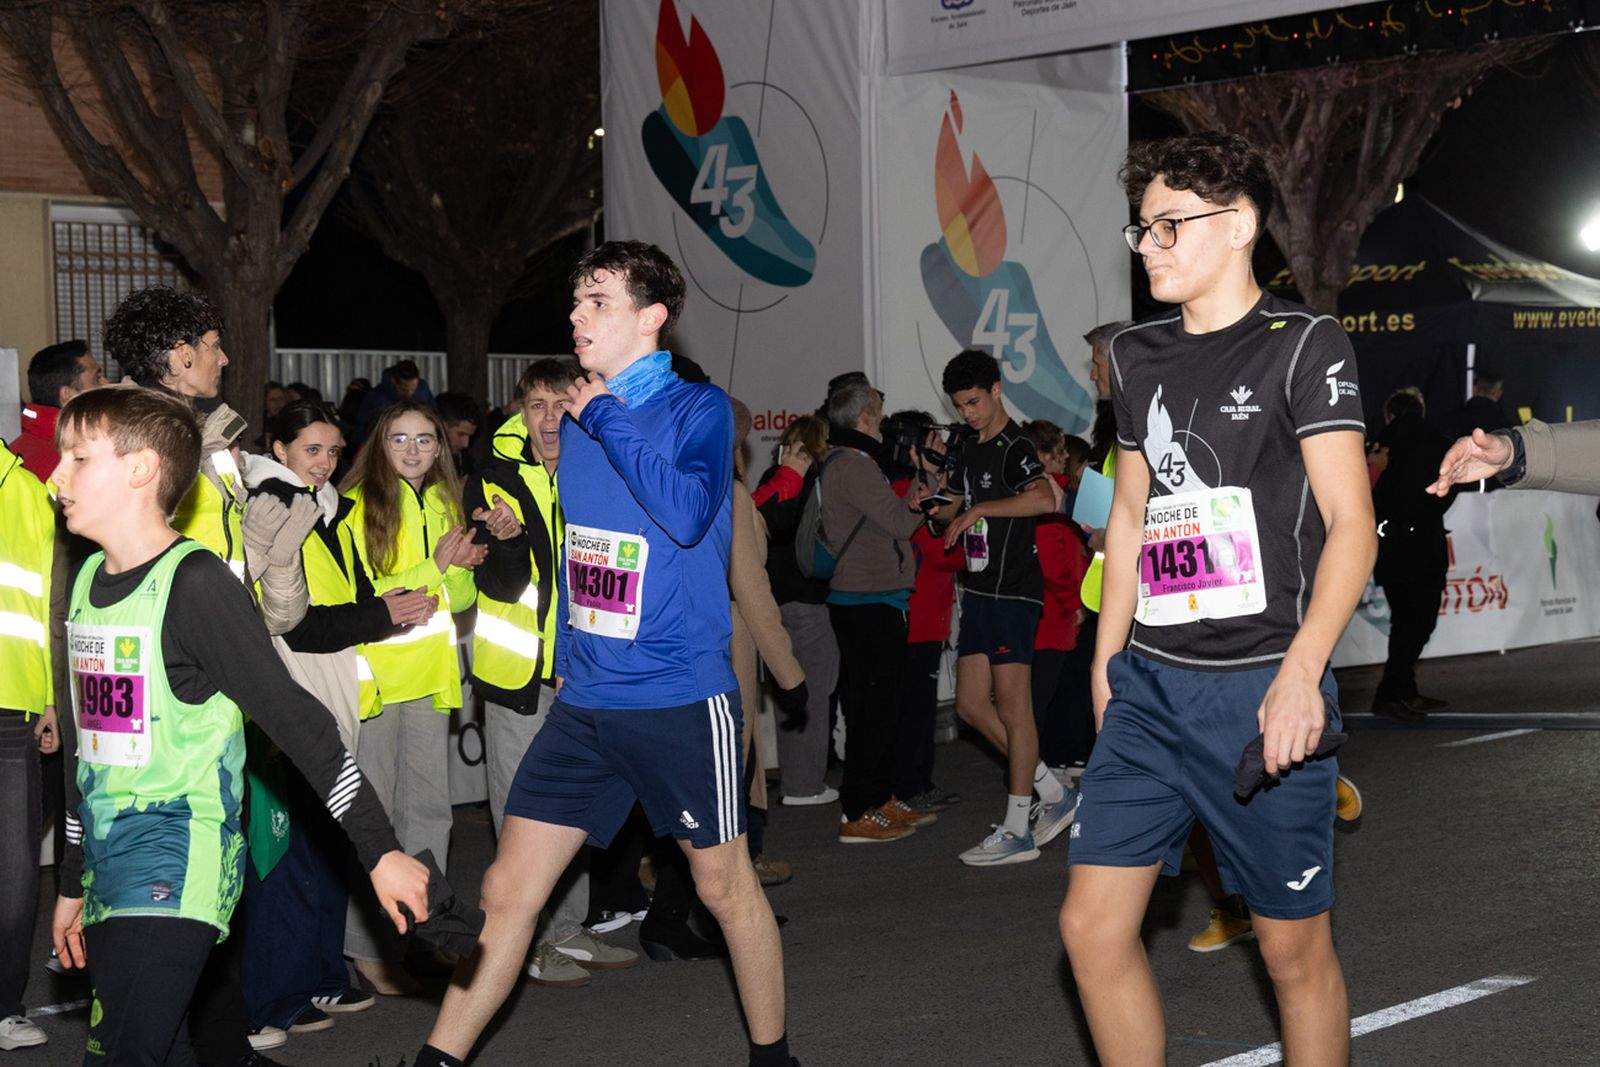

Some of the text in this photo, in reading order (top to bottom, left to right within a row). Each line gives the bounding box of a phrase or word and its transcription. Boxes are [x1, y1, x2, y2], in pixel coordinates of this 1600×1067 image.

[1051, 4, 1060, 12] de
[690, 144, 758, 239] 43
[971, 288, 1039, 384] 43
[1220, 405, 1262, 413] CAJA RURAL
[1231, 412, 1250, 421] JAÉN
[1158, 452, 1186, 487] 43
[1150, 508, 1182, 526] NOCHE
[1184, 506, 1199, 520] DE
[1162, 518, 1201, 540] ANTÓN
[577, 538, 601, 552] NOCHE
[601, 542, 611, 553] DE
[571, 548, 582, 562] SAN
[582, 550, 609, 567] ANTÓN
[573, 564, 629, 603] 14301
[1162, 577, 1223, 593] Francisco Javier
[95, 641, 105, 655] DE
[80, 654, 105, 673] ANTÓN
